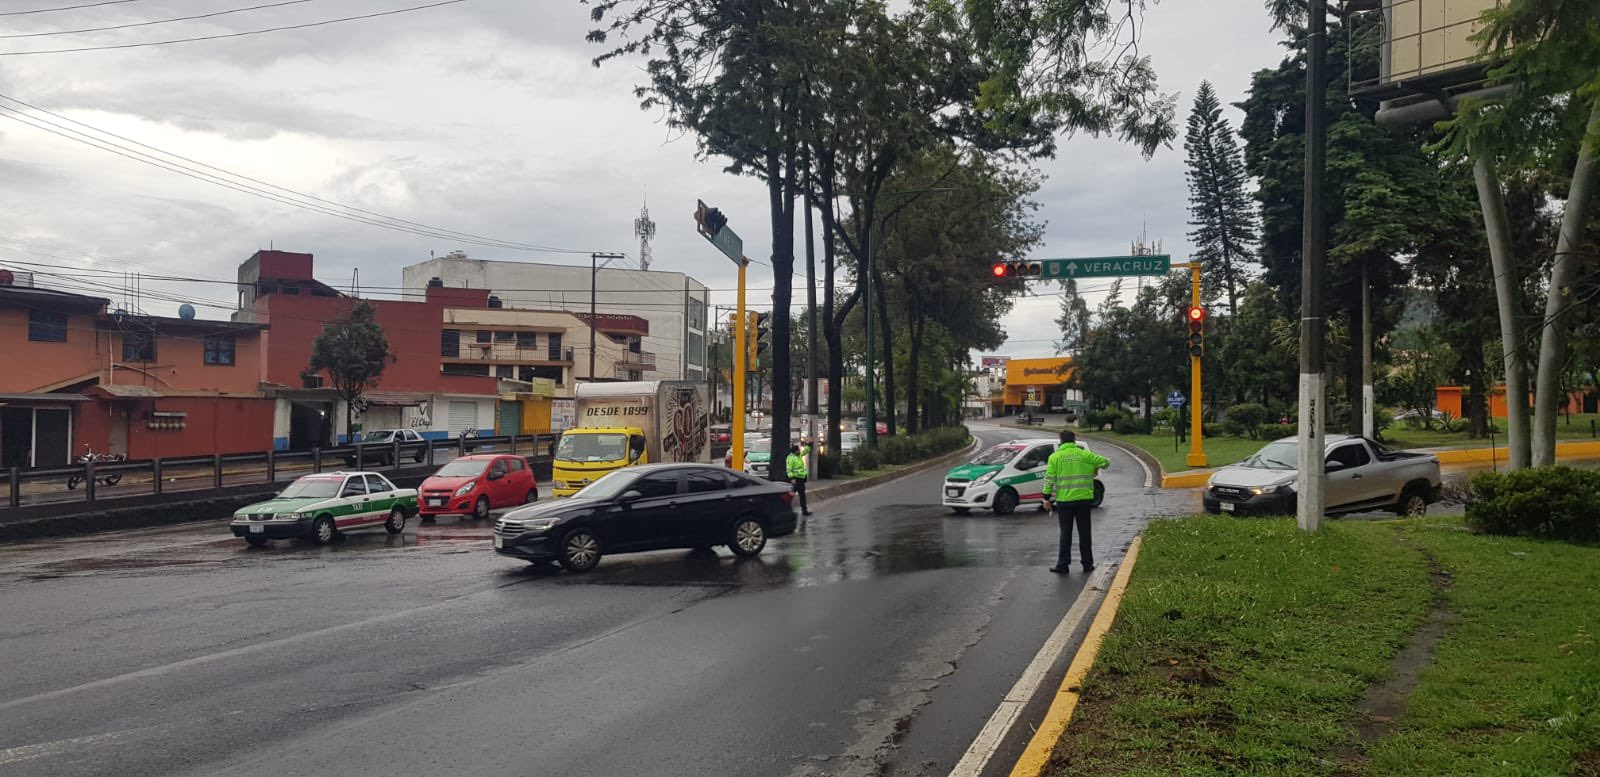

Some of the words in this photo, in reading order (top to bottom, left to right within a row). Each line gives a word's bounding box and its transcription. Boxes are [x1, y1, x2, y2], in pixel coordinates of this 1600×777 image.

[1084, 260, 1163, 273] VERACRUZ
[587, 407, 619, 416] DESDE
[623, 406, 648, 416] 1899
[352, 503, 363, 511] TAXI
